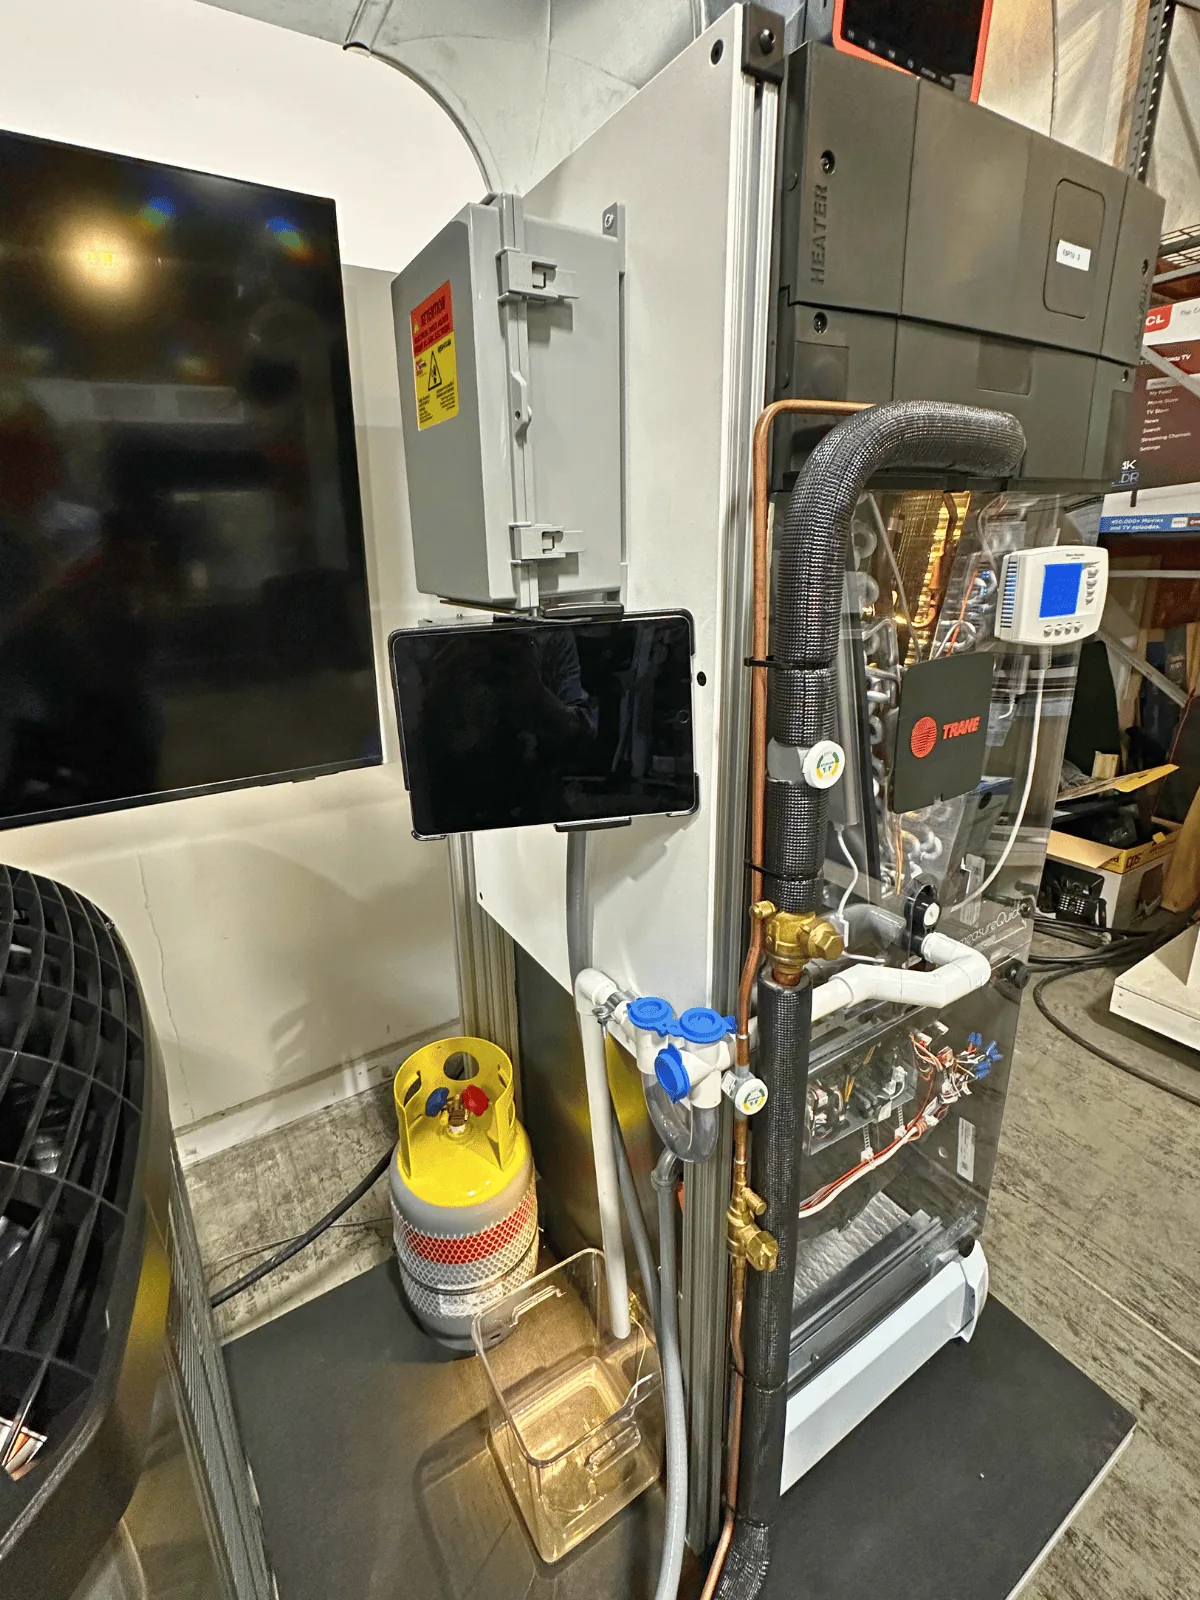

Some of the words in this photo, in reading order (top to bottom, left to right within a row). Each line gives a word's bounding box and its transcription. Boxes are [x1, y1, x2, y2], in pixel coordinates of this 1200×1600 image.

[810, 184, 828, 286] HEATER
[1145, 314, 1165, 326] CL
[942, 716, 980, 740] TRANE
